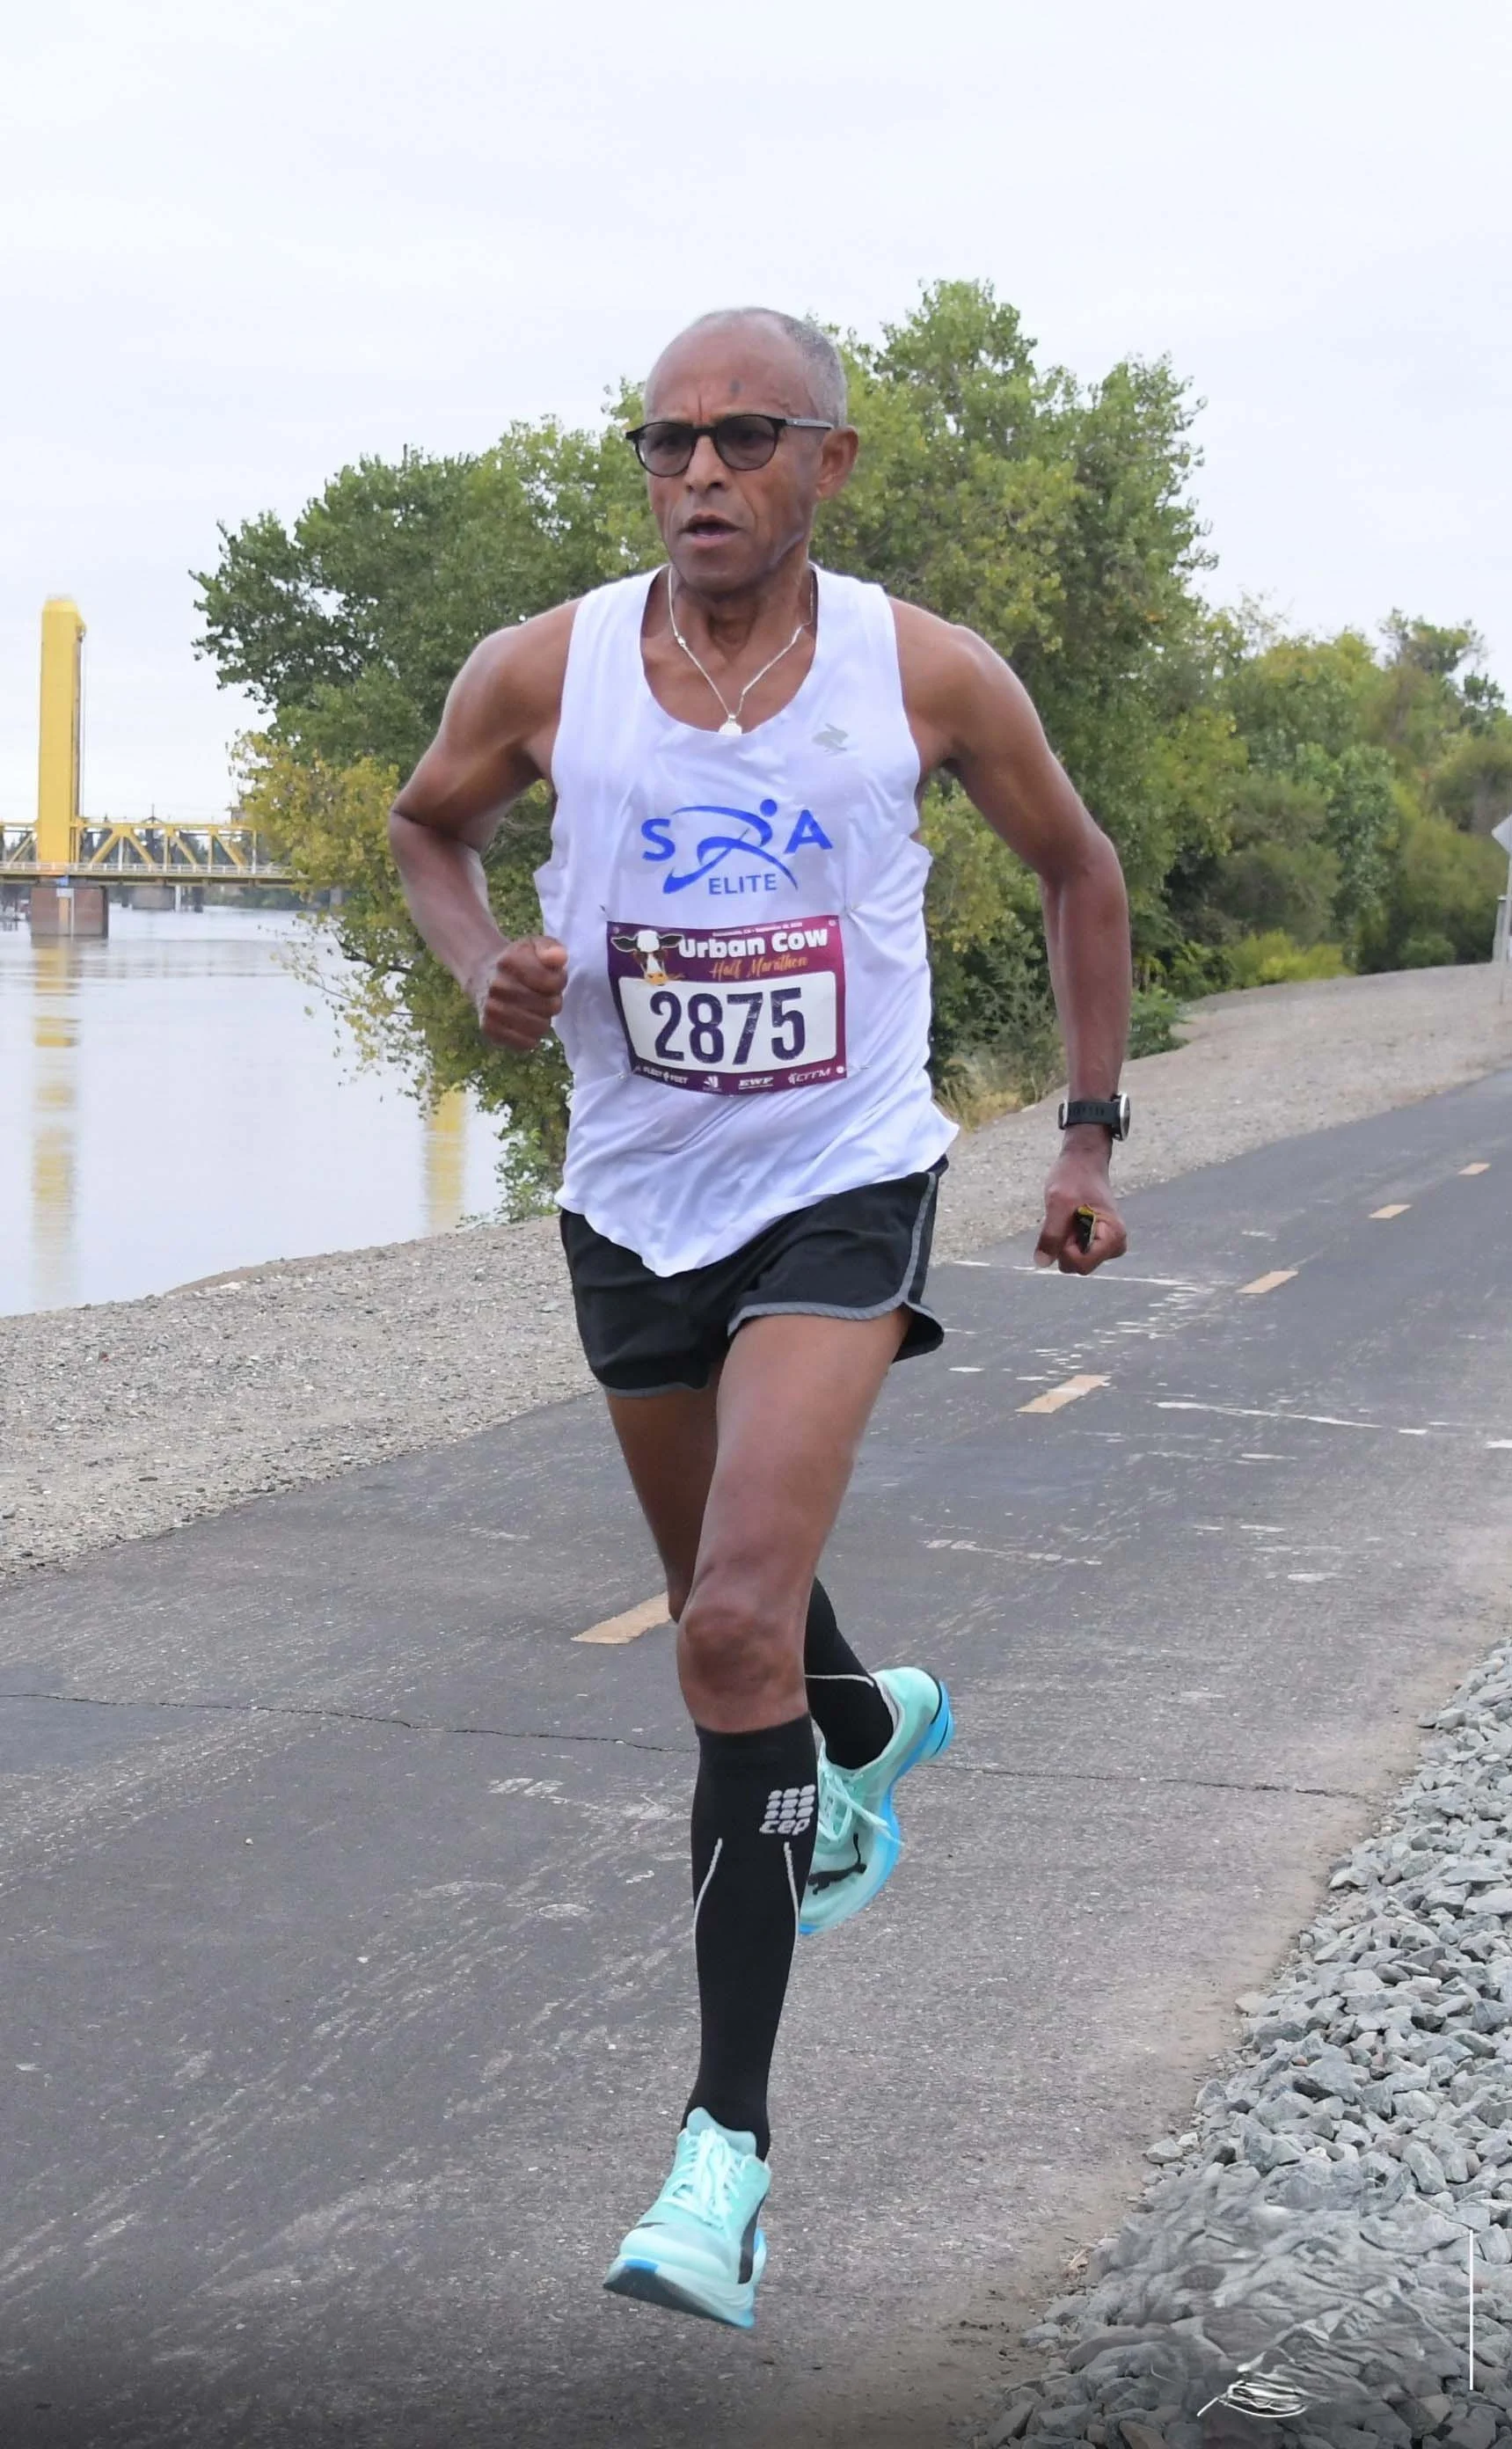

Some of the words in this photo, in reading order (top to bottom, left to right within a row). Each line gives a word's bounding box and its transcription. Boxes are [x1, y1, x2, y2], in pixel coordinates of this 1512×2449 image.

[708, 874, 777, 895] ELITE
[678, 937, 765, 958] Urban
[709, 959, 742, 982] Half
[746, 955, 808, 978] Marathon
[650, 987, 806, 1065] 2875
[759, 1817, 810, 1837] cep
